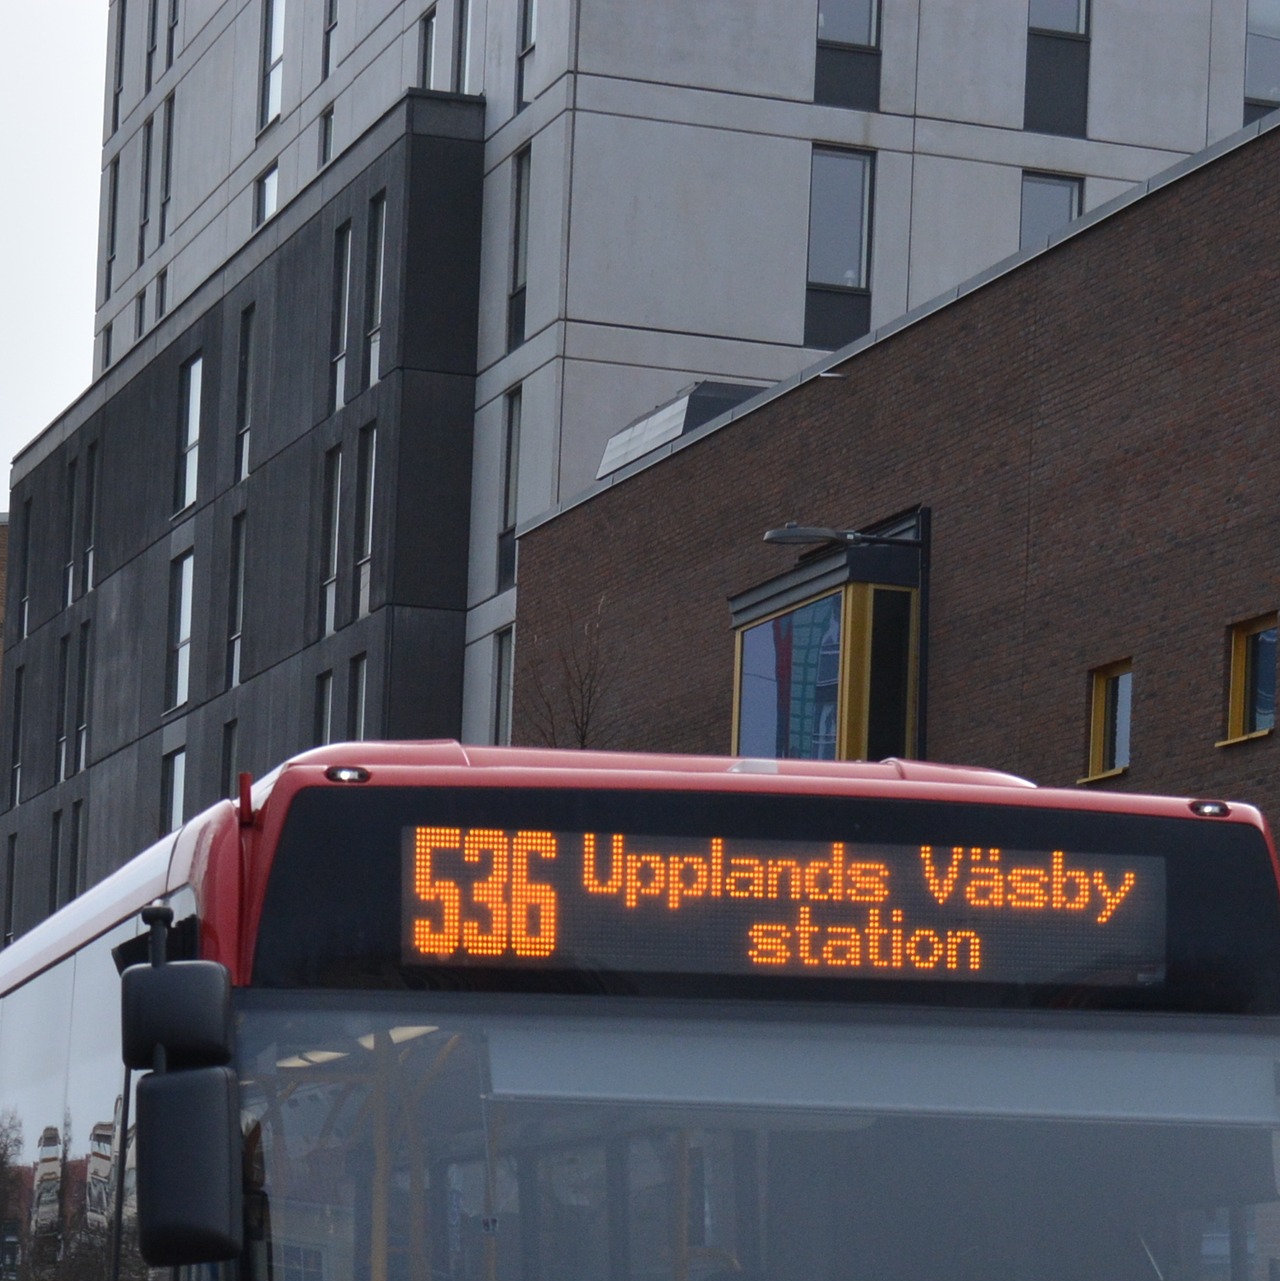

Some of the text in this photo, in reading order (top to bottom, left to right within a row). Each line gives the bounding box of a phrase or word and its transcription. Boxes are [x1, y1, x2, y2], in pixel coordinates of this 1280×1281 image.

[414, 826, 1136, 957] 536 Upplands Väsby
[748, 905, 982, 970] station
